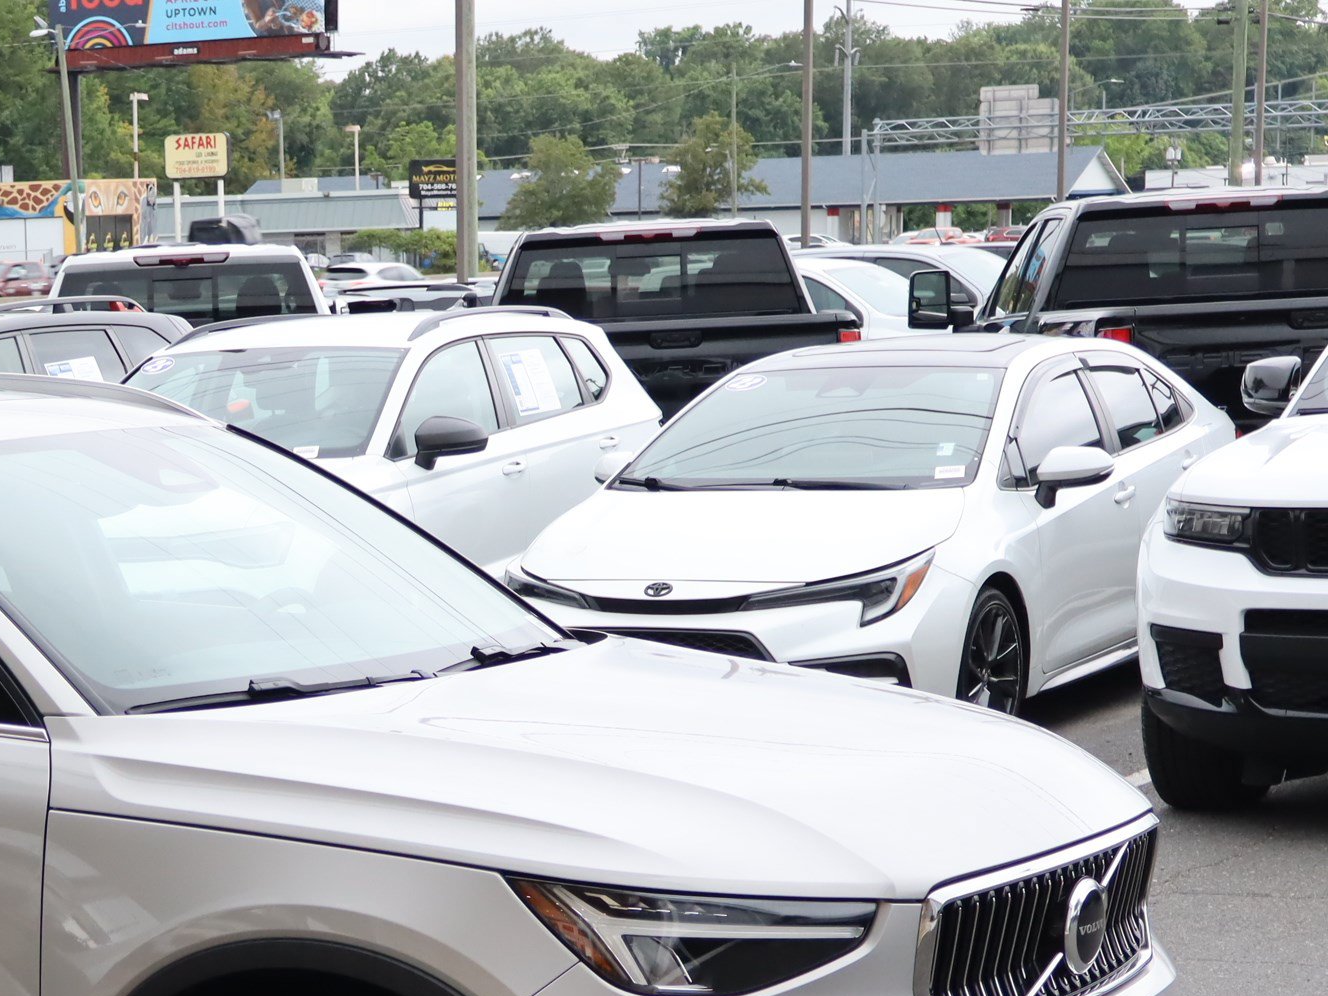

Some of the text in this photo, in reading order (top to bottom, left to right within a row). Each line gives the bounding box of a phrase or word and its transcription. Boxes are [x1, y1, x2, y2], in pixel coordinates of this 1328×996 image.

[165, 6, 217, 19] UPTOWN
[173, 46, 198, 55] adams
[175, 135, 217, 150] SAFARI
[412, 174, 435, 183] MAYZ
